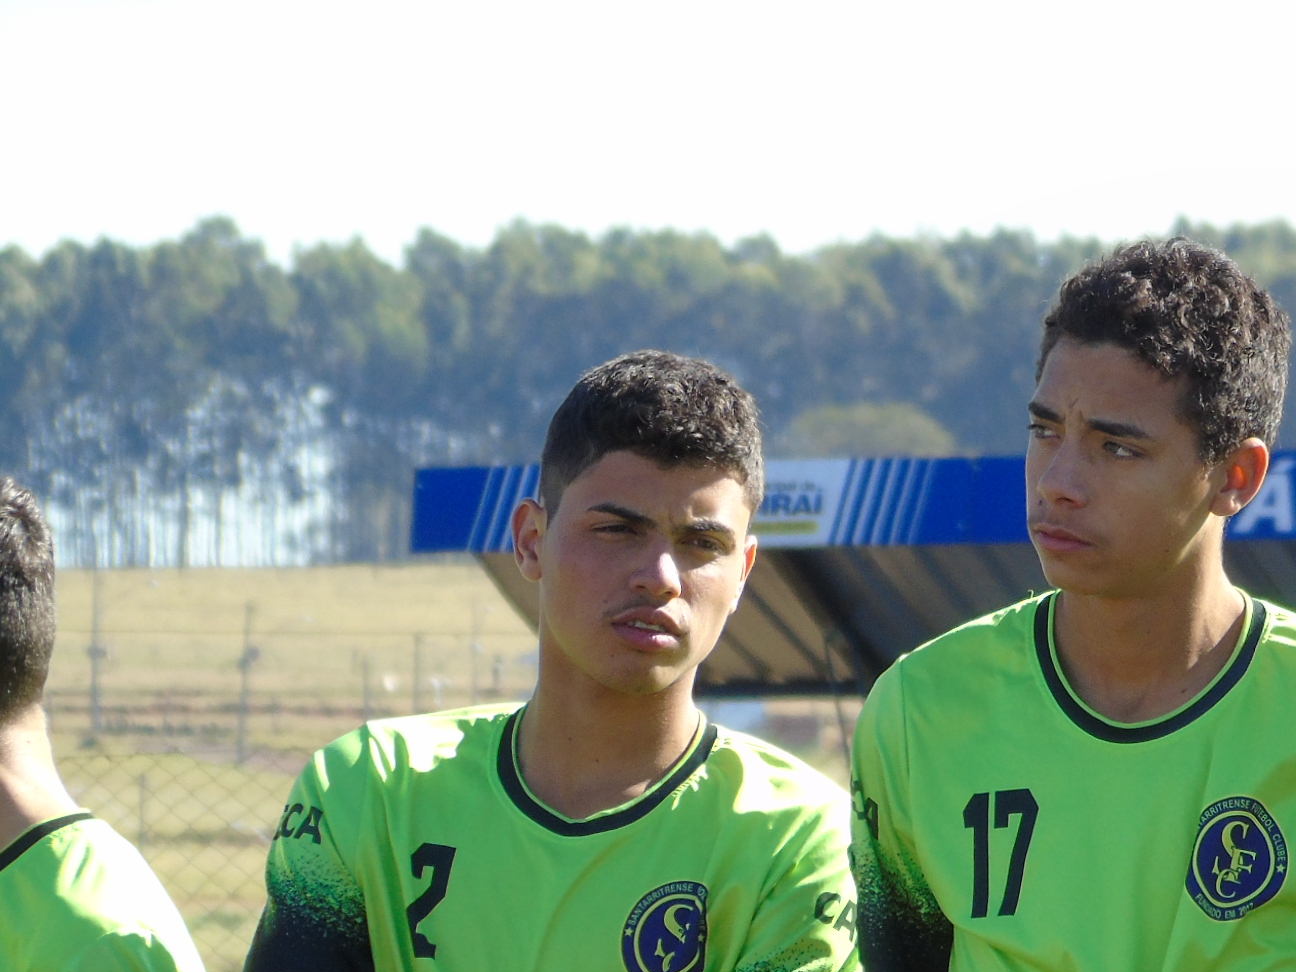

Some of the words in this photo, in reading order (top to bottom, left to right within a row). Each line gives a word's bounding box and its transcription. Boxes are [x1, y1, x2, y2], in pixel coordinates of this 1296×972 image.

[963, 788, 1040, 918] 17
[1272, 833, 1286, 862] CLUBE
[406, 842, 457, 960] 2
[1225, 910, 1236, 919] EM
